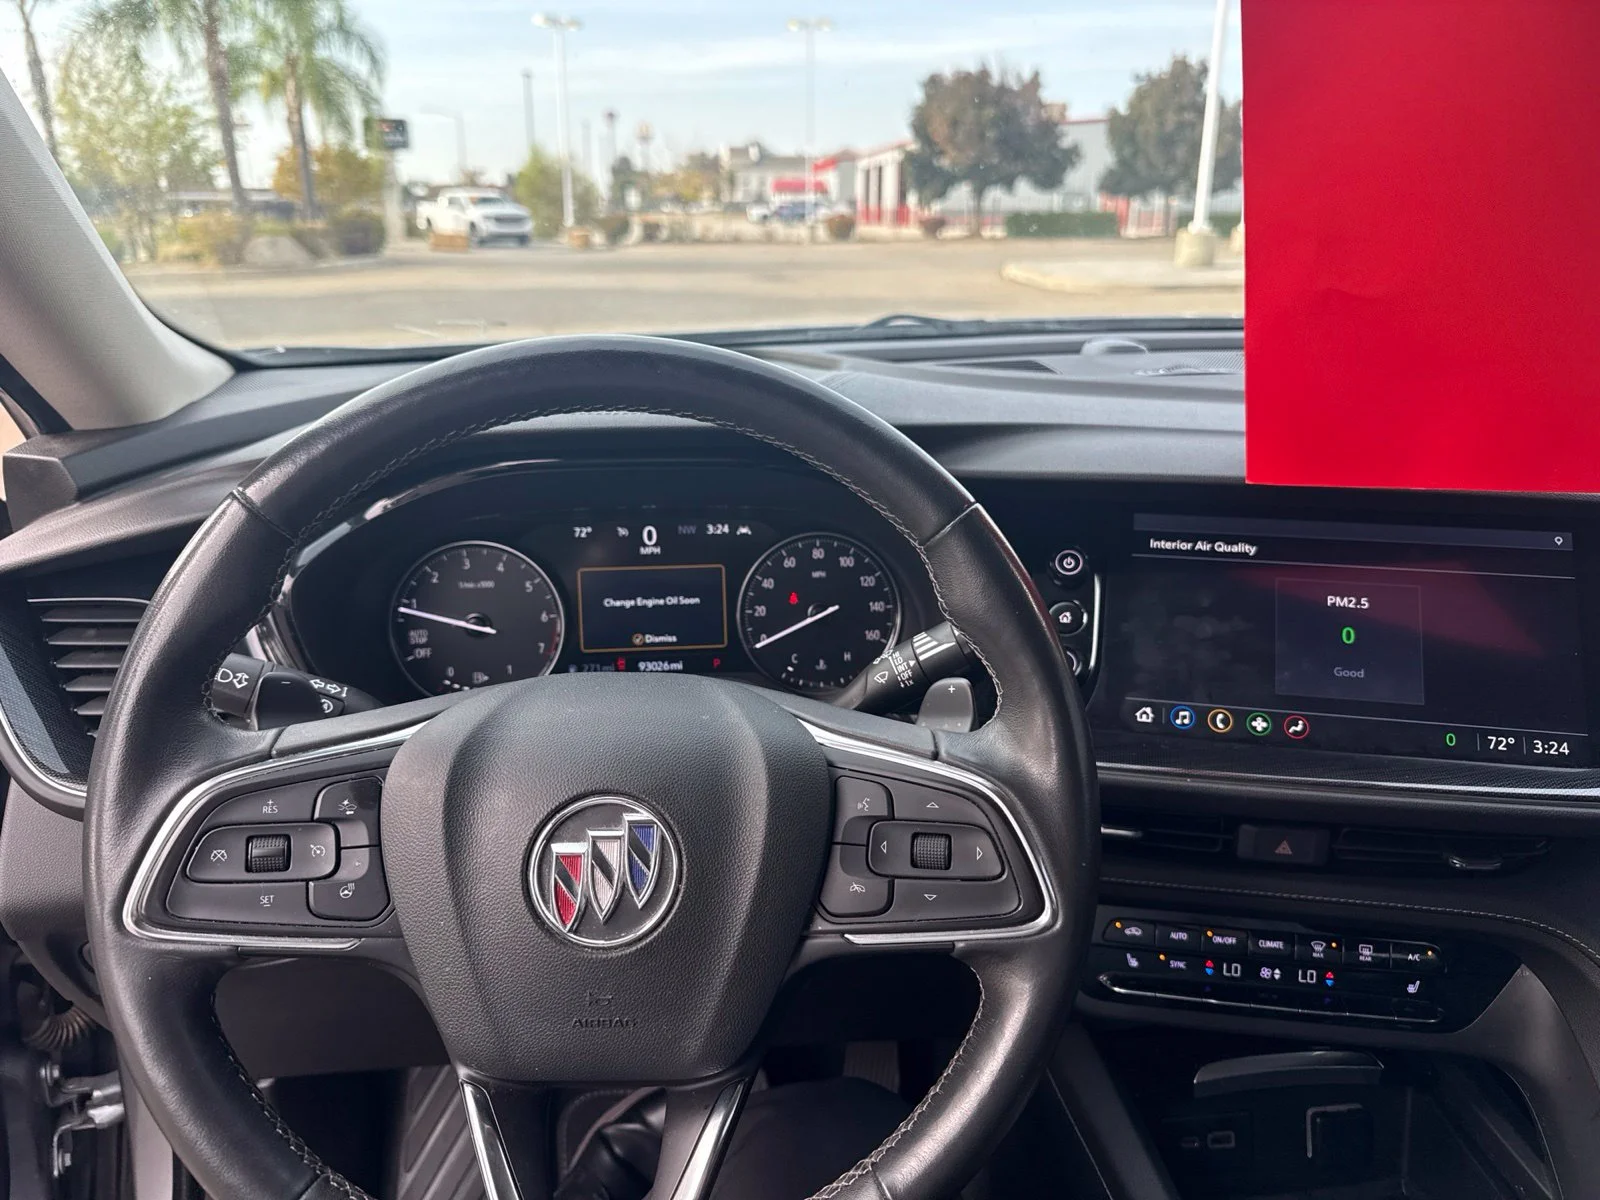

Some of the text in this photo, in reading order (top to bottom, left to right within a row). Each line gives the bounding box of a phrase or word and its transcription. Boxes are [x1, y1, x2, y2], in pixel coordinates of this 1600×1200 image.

[678, 525, 697, 535] NW
[705, 524, 730, 535] 3:24
[641, 525, 658, 546] 0
[639, 546, 661, 555] MPH
[1149, 538, 1257, 556] Interior Air Quality
[811, 548, 825, 559] 80
[463, 558, 471, 569] 3
[496, 562, 505, 572] 4
[783, 557, 796, 568] 60
[838, 557, 855, 567] 100
[431, 571, 439, 583] 2
[860, 576, 876, 587] 120
[525, 581, 533, 592] 5
[761, 578, 775, 589] 40
[603, 596, 700, 608] Change Engine Oil Soon
[869, 602, 885, 612] 140
[1326, 595, 1370, 610] PM2.5
[541, 611, 549, 622] 6
[754, 606, 766, 617] 20
[645, 634, 677, 643] Dismiss
[864, 630, 880, 640] 160
[1341, 627, 1355, 645] 0
[415, 648, 432, 658] OFF
[538, 643, 544, 653] 7
[791, 653, 798, 664] C
[843, 652, 851, 661] H
[893, 657, 903, 666] LO
[713, 658, 721, 668] P
[897, 662, 908, 673] INT
[900, 669, 912, 680] OFF
[1333, 667, 1364, 678] Good
[1445, 733, 1456, 747] 0
[1487, 736, 1515, 751] 72°
[1532, 740, 1570, 756] 3:24
[262, 805, 278, 814] RES
[260, 895, 274, 904] SET
[1169, 931, 1188, 940] AUTO
[1212, 936, 1237, 945] ON/OFF
[1258, 939, 1284, 949] CLIMATE
[1407, 953, 1421, 962] A/C
[1169, 960, 1187, 969] SYNC
